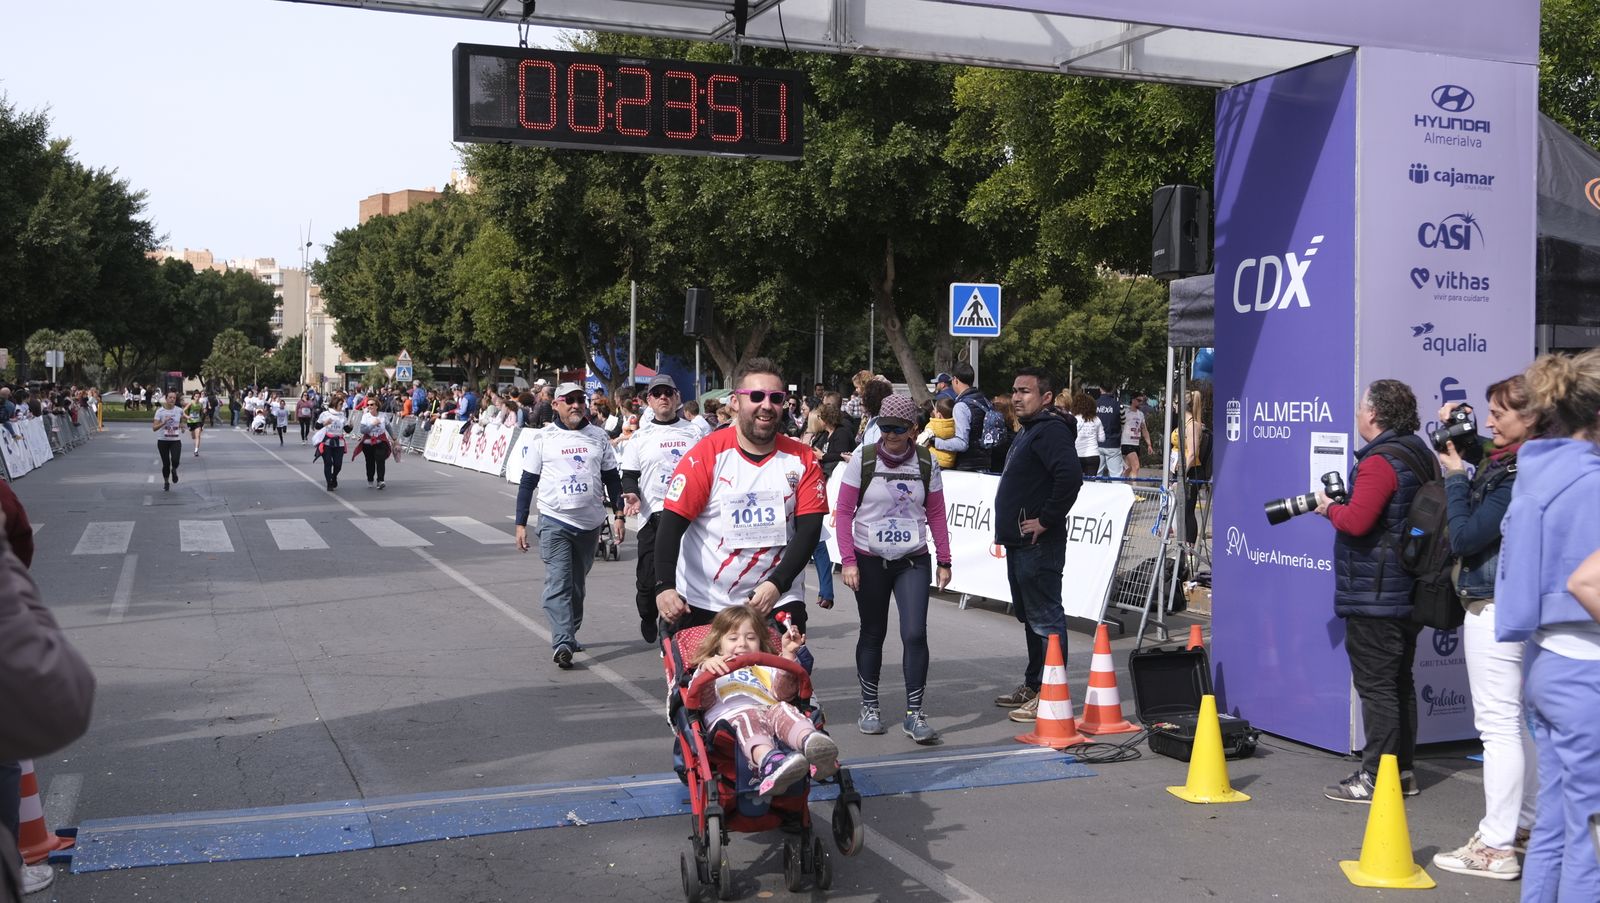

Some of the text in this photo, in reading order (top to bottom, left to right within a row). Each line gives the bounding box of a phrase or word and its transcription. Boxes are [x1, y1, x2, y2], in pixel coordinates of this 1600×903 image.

[518, 58, 788, 144] 00:23:51
[1414, 114, 1490, 133] HYUNDAI
[1424, 132, 1482, 148] Almerialva
[1433, 168, 1495, 187] cajamar
[1418, 222, 1471, 250] CASI
[1233, 235, 1324, 313] CDX
[1435, 271, 1490, 290] vithas
[1423, 333, 1487, 356] aqualia
[1253, 397, 1333, 422] ALMERÍA
[1253, 425, 1291, 439] CIUDAD
[561, 447, 588, 455] MUJER
[561, 482, 588, 494] 1143
[731, 507, 776, 525] 1013
[876, 530, 912, 543] 1289
